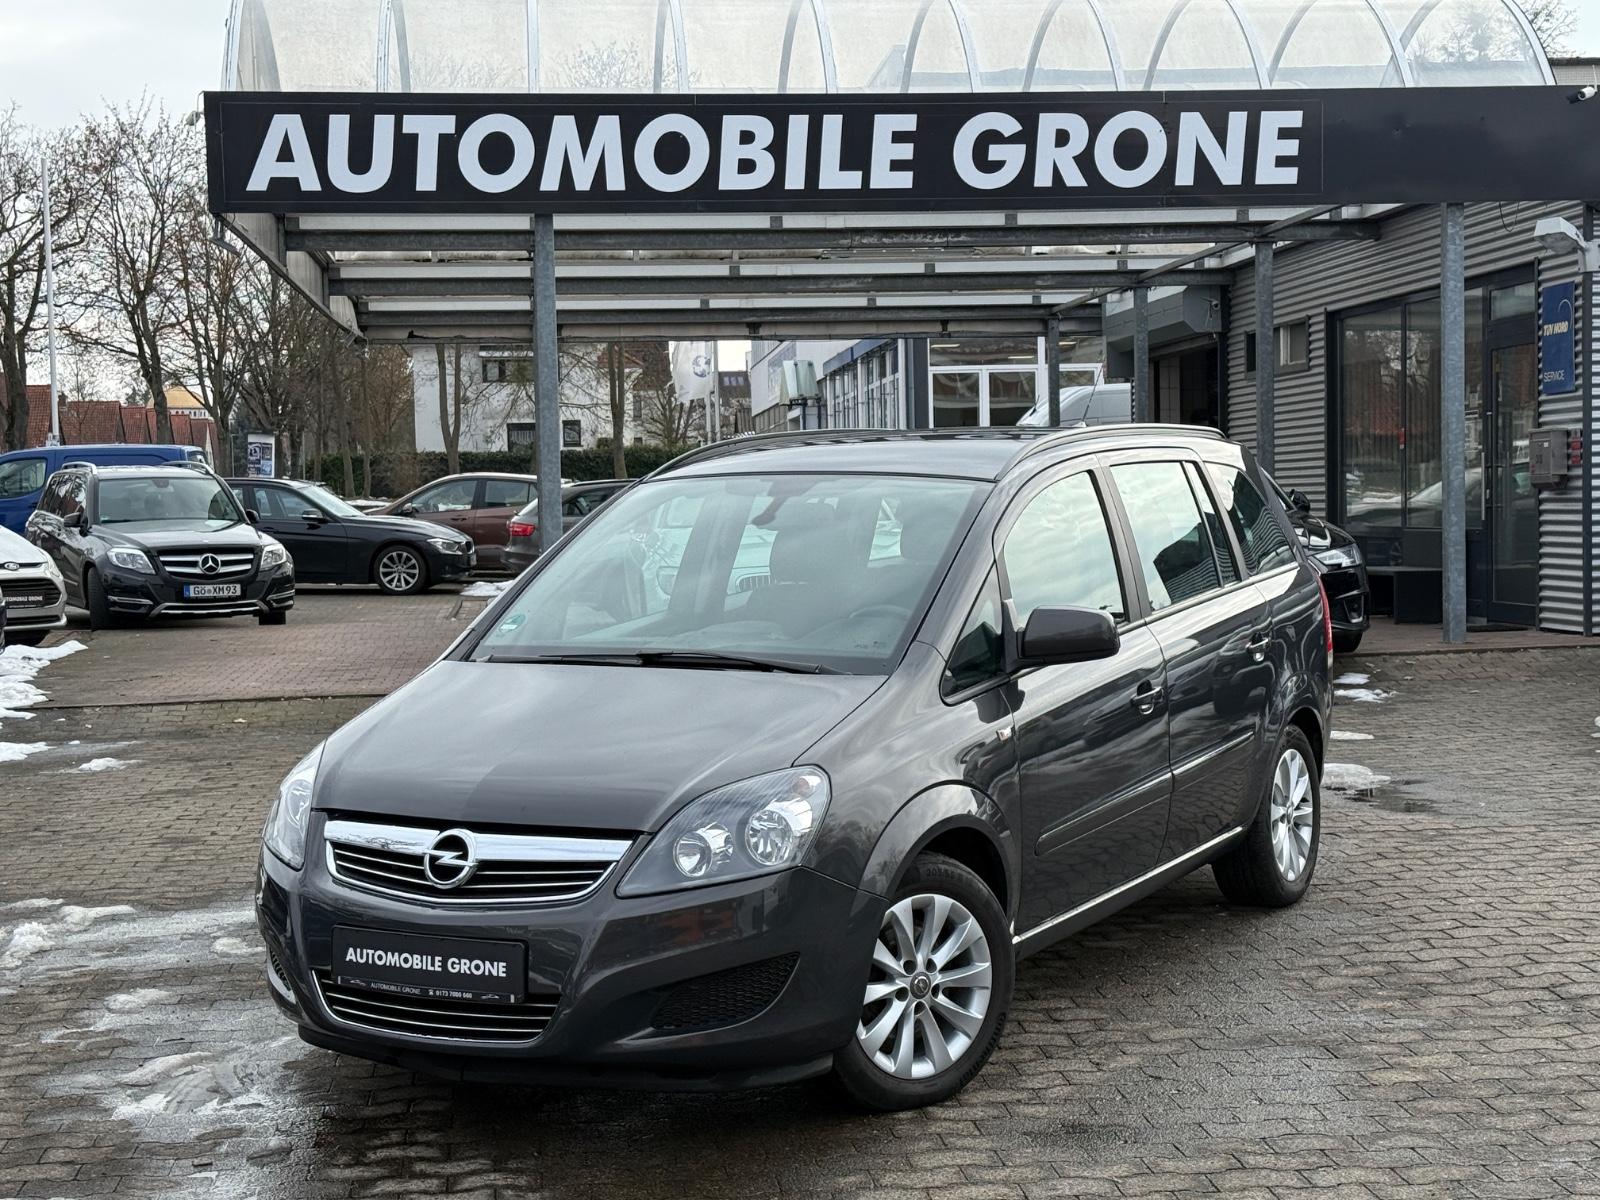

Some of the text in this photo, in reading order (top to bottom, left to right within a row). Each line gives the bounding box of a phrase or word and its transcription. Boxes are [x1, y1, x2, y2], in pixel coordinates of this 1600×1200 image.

[246, 110, 1303, 194] AUTOMOBILE GRONE
[1544, 370, 1564, 382] SERVICE
[194, 586, 206, 595] GÖ
[345, 947, 507, 977] AUTOMOBILE GRONE
[370, 982, 401, 992] AUTOMOBILE
[402, 986, 421, 995] GRONE
